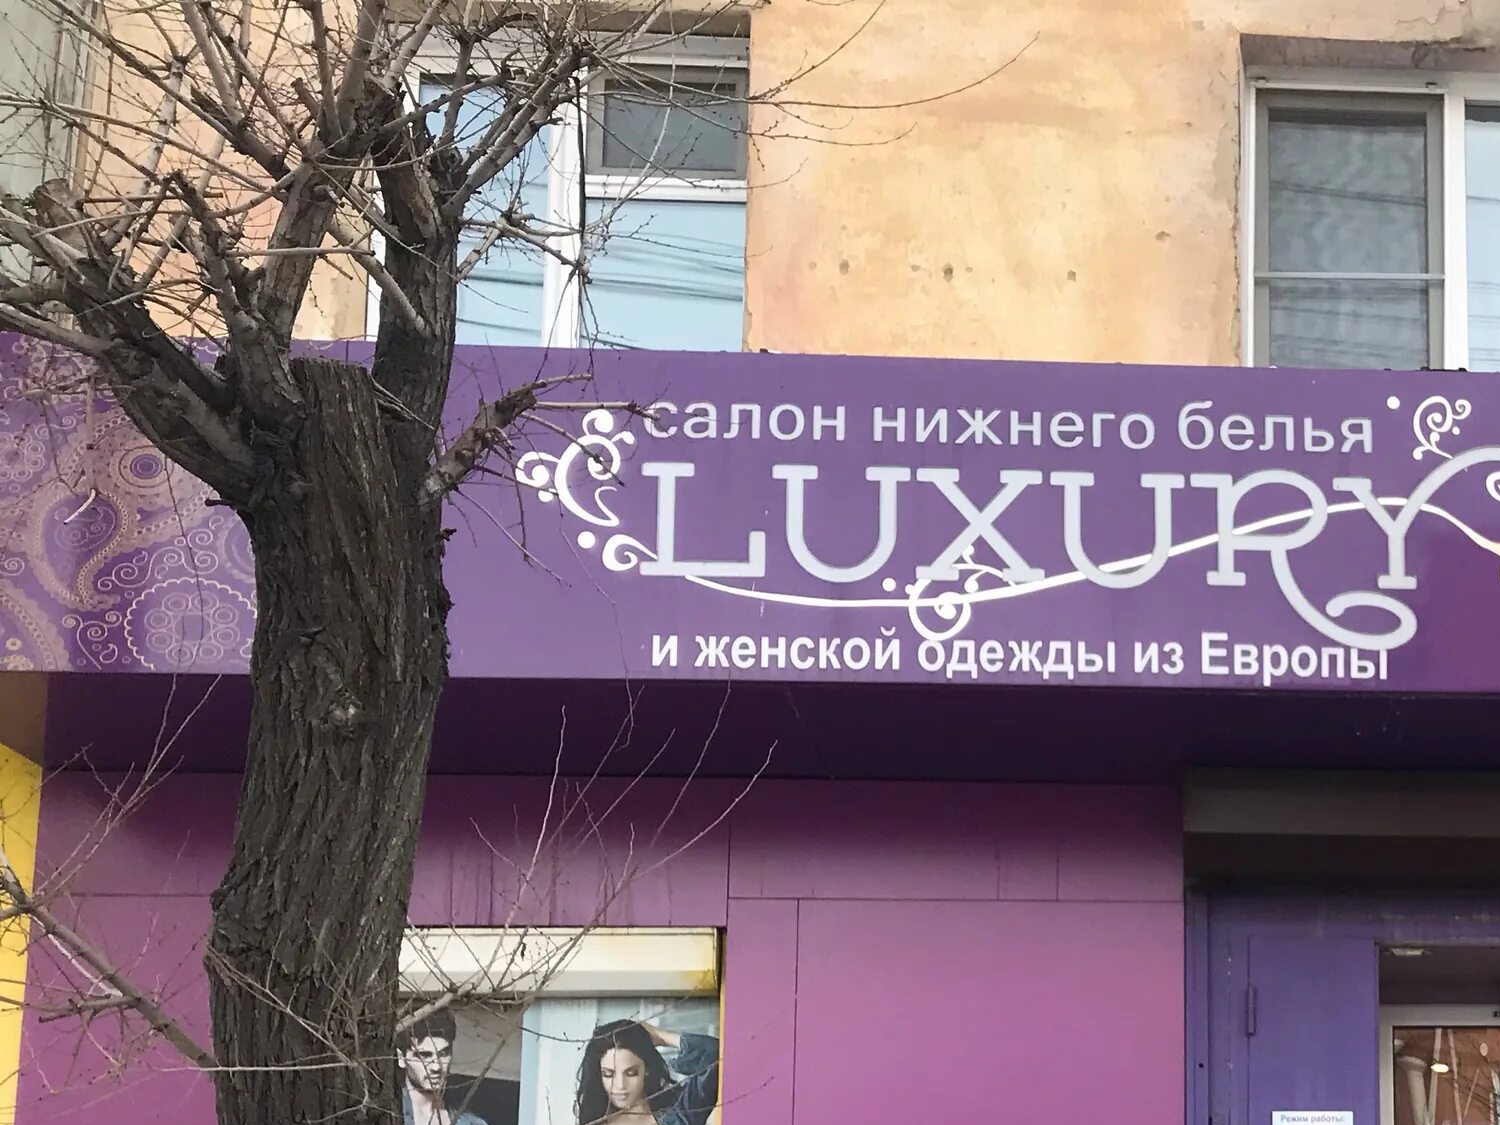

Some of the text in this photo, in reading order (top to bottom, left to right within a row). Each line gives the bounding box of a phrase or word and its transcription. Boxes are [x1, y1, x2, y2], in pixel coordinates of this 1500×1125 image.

[642, 399, 1375, 454] салон нижнего белья
[650, 626, 1389, 687] и женской одежды из Европы
[1280, 1114, 1308, 1123] Режим
